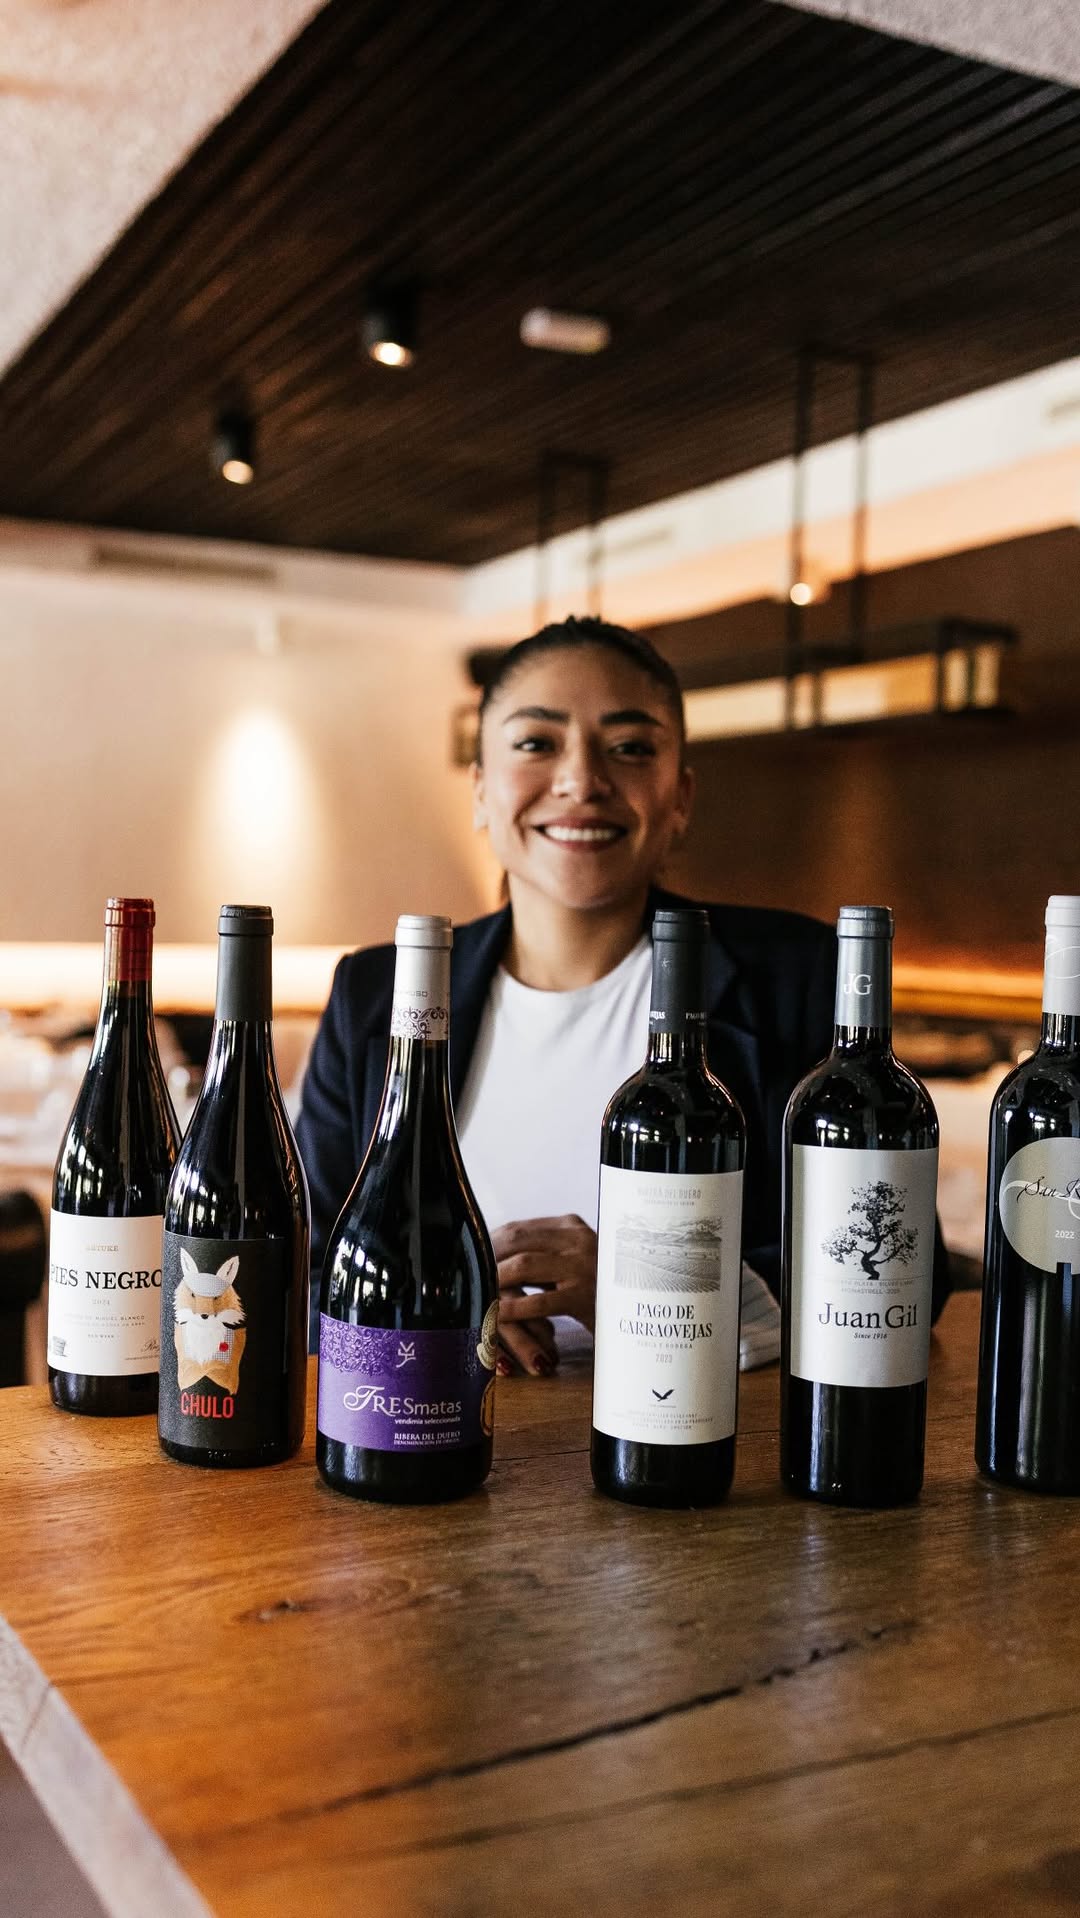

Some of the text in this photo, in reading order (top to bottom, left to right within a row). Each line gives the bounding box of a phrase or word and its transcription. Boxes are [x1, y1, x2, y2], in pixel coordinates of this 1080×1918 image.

[1016, 1176, 1056, 1204] San
[1055, 1230, 1075, 1240] 2022
[636, 1303, 695, 1320] PAGO DE
[619, 1318, 713, 1342] CARRAOVEJAS
[656, 1354, 673, 1364] 2023
[180, 1391, 234, 1419] CHULO
[394, 1417, 424, 1425] vendimia
[394, 1432, 420, 1441] RIBERA
[422, 1432, 435, 1440] DEL
